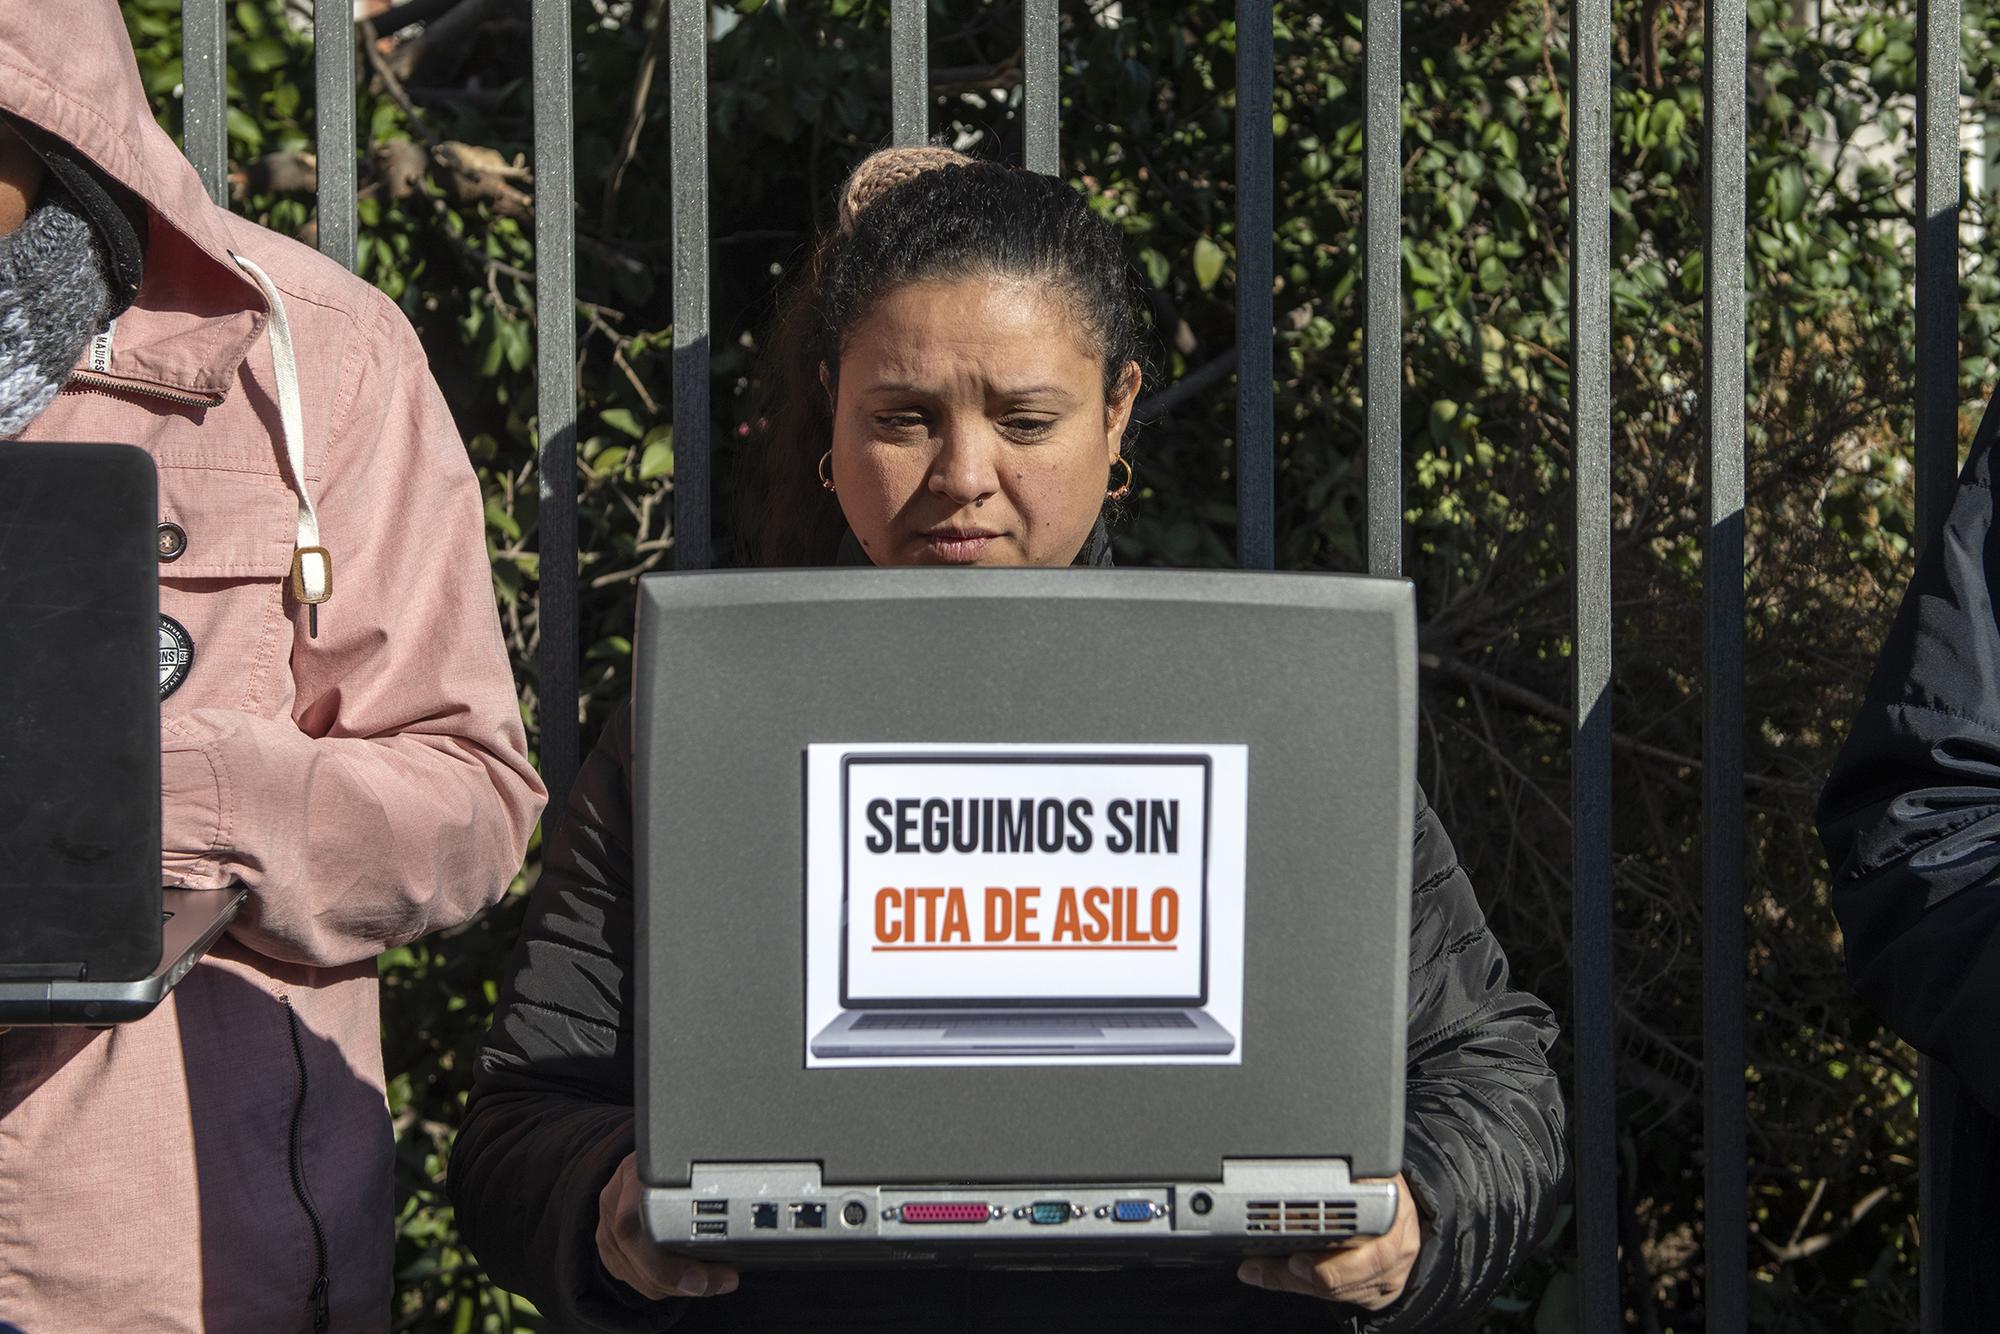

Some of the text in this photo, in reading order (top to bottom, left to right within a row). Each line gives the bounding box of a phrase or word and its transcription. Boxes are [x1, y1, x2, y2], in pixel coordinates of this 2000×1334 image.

[159, 651, 175, 663] NS
[865, 797, 1179, 854] SEGUIMOS SIN
[874, 886, 1179, 944] CITA DE ASILO
